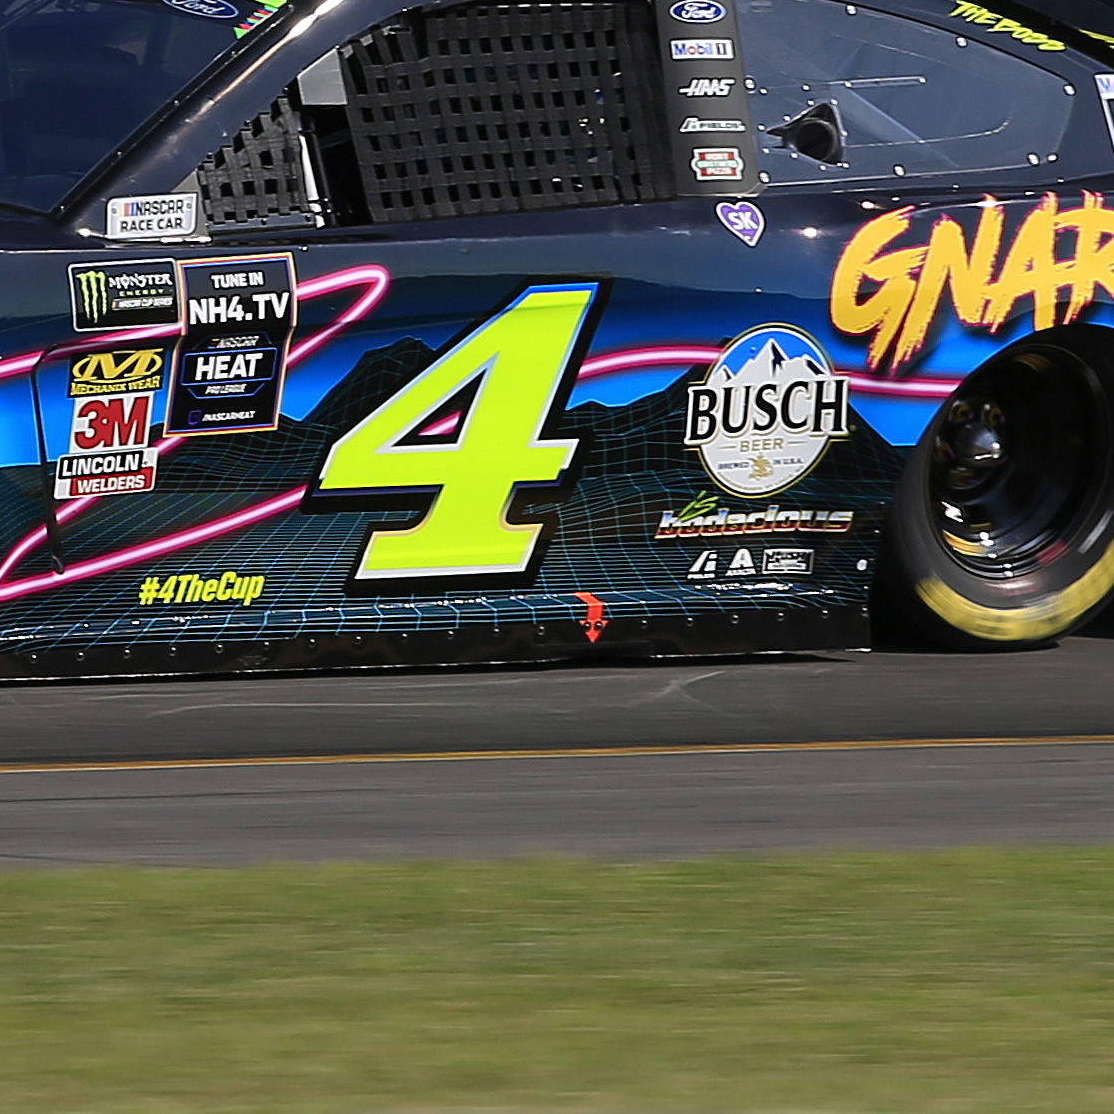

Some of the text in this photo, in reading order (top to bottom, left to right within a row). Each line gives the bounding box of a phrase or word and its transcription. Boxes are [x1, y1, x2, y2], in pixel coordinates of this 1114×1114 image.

[681, 1, 717, 19] Ford
[673, 42, 728, 56] Mobil 1
[135, 199, 185, 216] NASCAR
[120, 217, 185, 233] RACE CAR
[728, 212, 759, 231] SK
[211, 272, 264, 289] TUNE IN
[118, 288, 165, 297] ENERGY
[189, 291, 290, 325] NH4.TV
[194, 352, 264, 381] HEAT
[70, 375, 161, 396] MECHANIX WEAR
[685, 377, 850, 445] BUSCH
[74, 395, 150, 450] 3M
[319, 283, 599, 580] 4
[739, 437, 785, 453] BEER
[61, 453, 140, 477] LINCOLN
[77, 474, 146, 494] WELDERS
[654, 504, 855, 539] bodacious
[138, 571, 266, 606] #4TheCup
